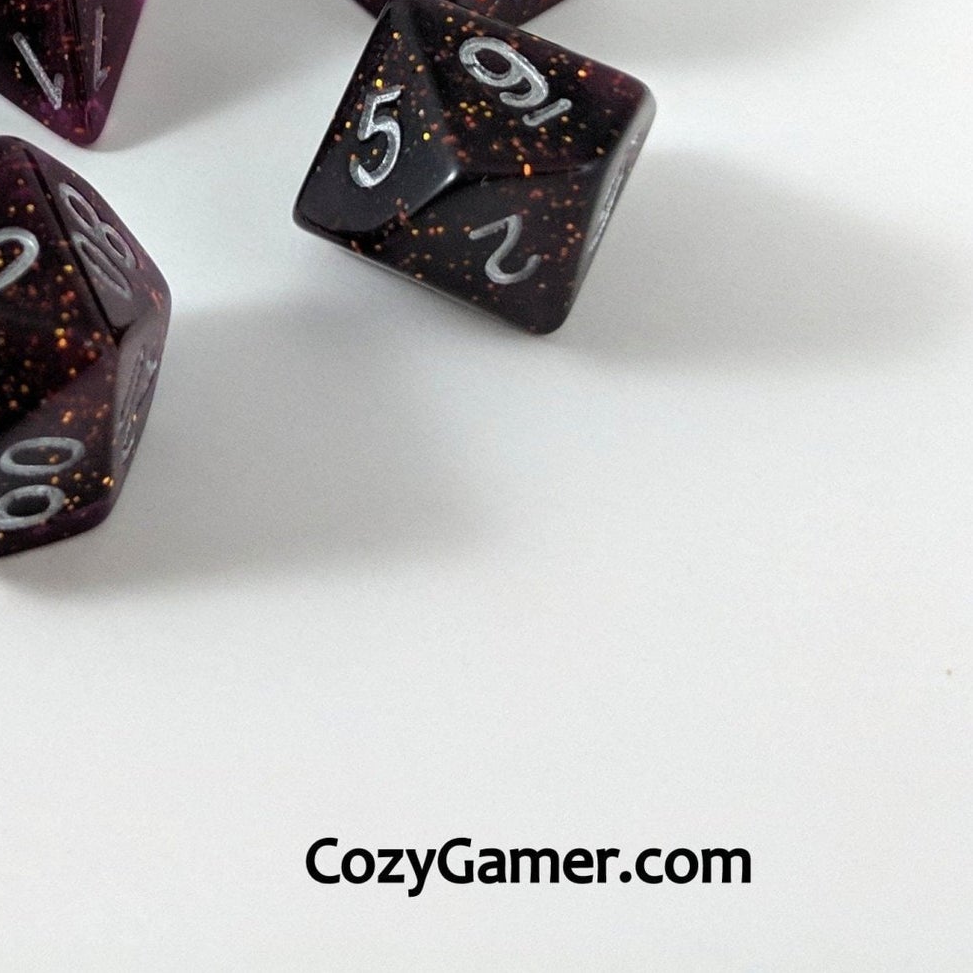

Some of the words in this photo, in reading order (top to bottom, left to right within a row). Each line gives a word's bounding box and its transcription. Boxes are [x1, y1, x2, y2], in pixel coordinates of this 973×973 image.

[12, 31, 64, 110] 1
[348, 84, 405, 188] 5
[468, 213, 542, 286] 2
